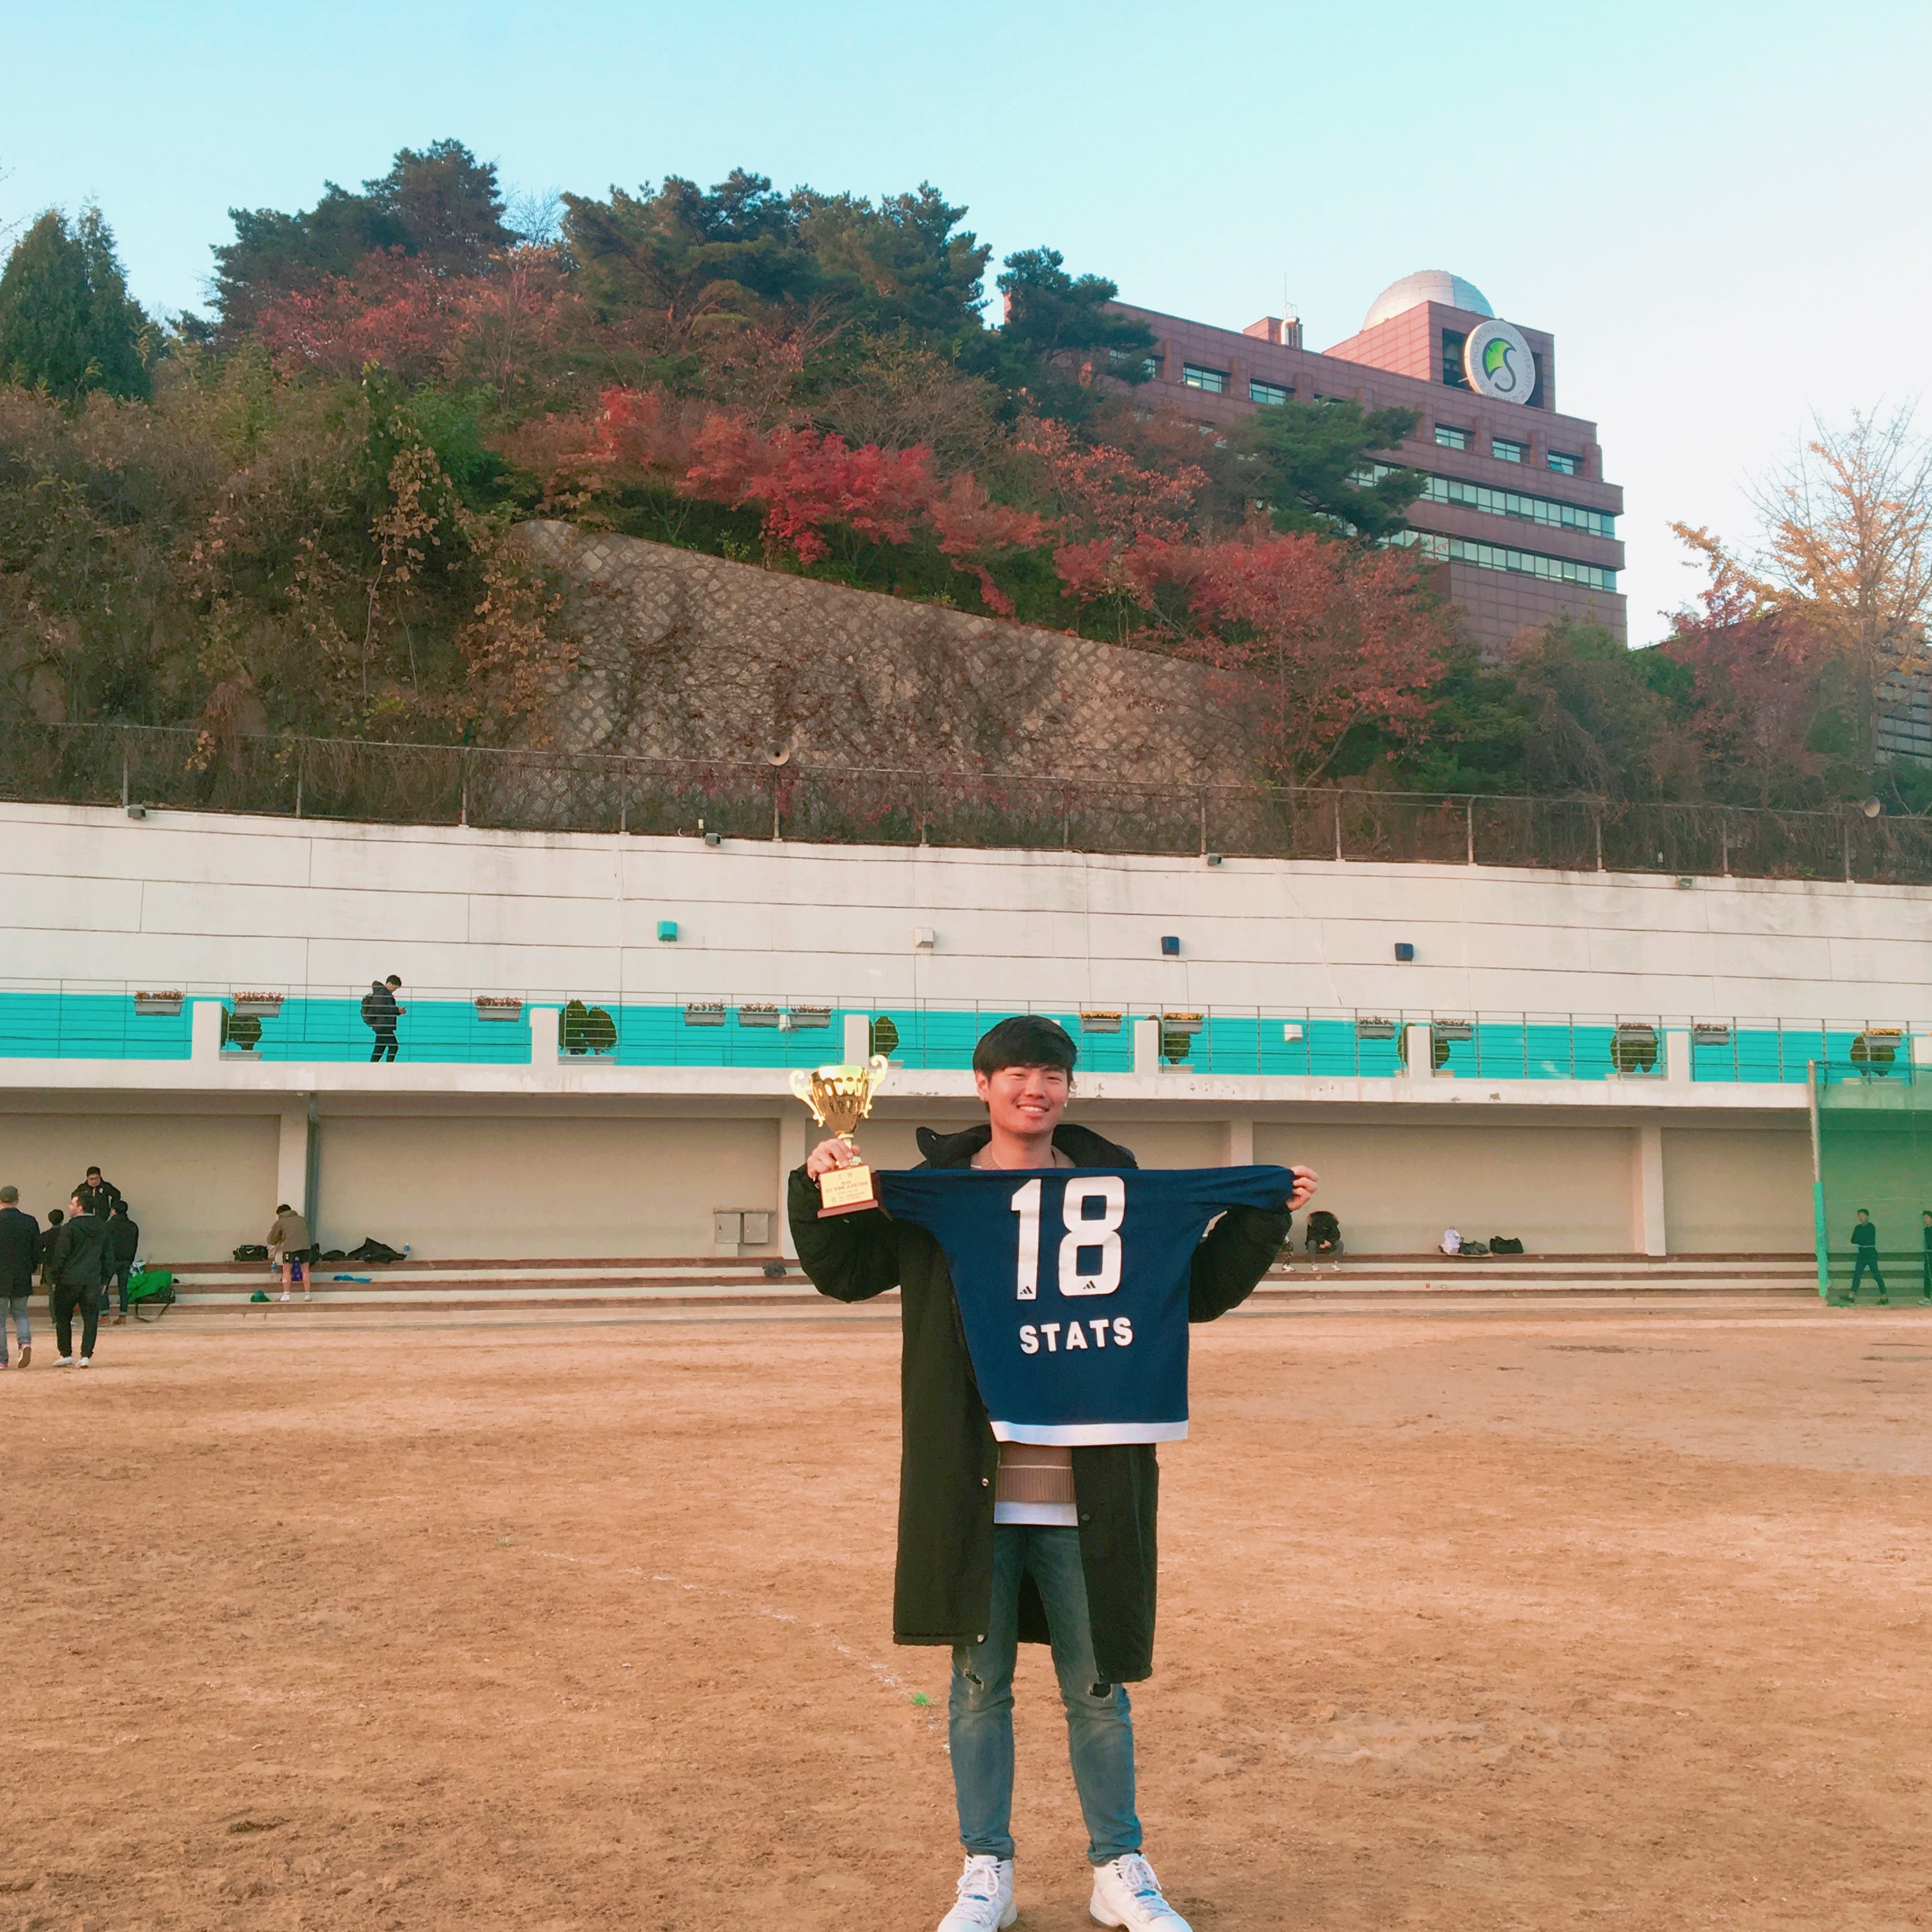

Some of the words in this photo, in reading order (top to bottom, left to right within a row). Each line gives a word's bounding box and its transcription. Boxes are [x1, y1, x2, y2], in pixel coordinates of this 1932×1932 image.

[1472, 325, 1514, 376] SUNGKYUNKWAN
[1514, 336, 1533, 389] UNIVERSITY
[1011, 1176, 1125, 1300] 18
[1020, 1317, 1133, 1354] STATS
